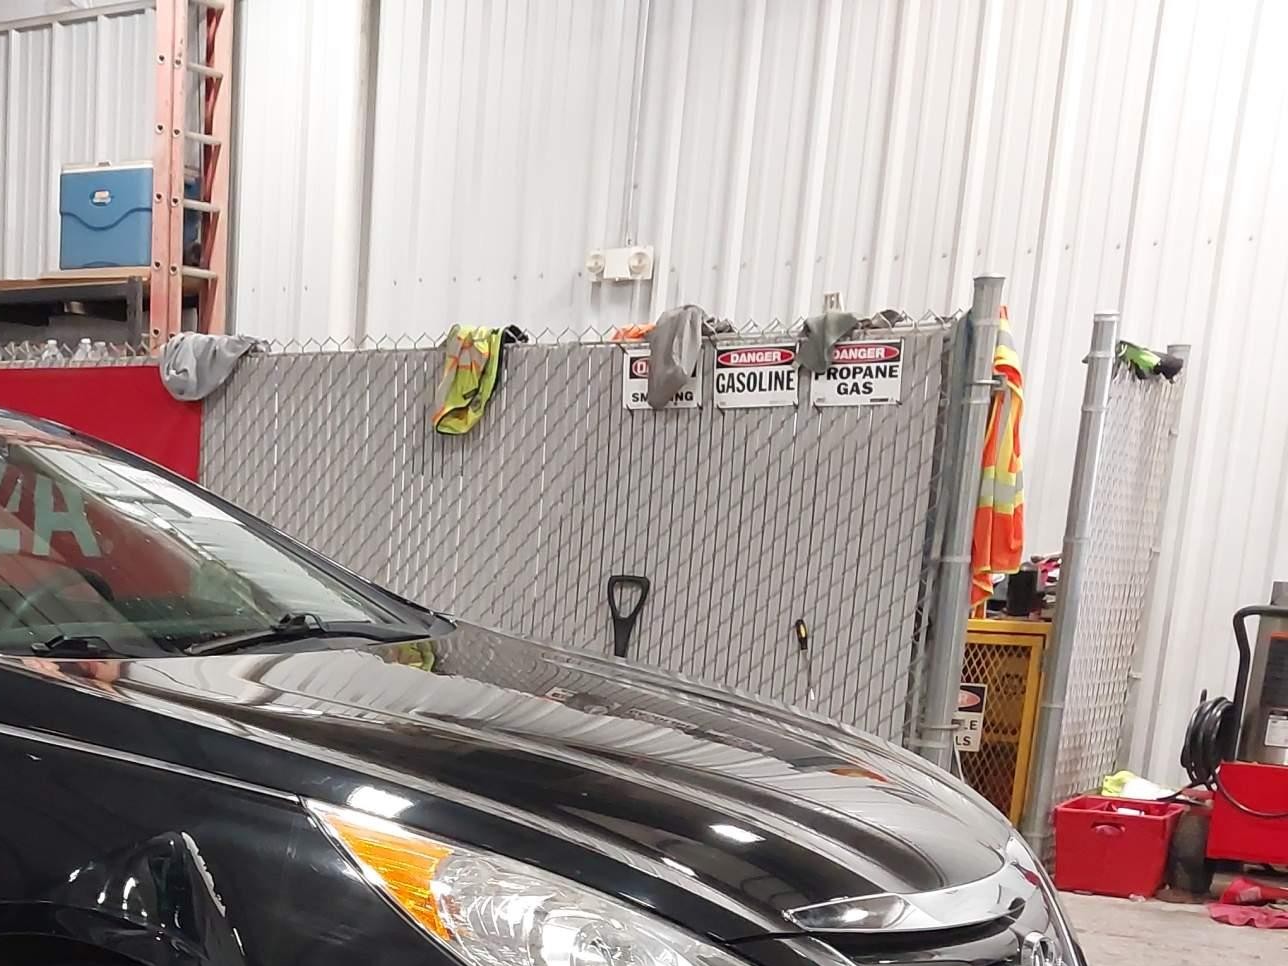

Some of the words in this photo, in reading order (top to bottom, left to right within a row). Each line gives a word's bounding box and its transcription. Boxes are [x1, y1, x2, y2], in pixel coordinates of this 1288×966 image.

[730, 351, 782, 363] DANGER
[715, 370, 796, 394] GASOLINE
[836, 381, 874, 396] GAS
